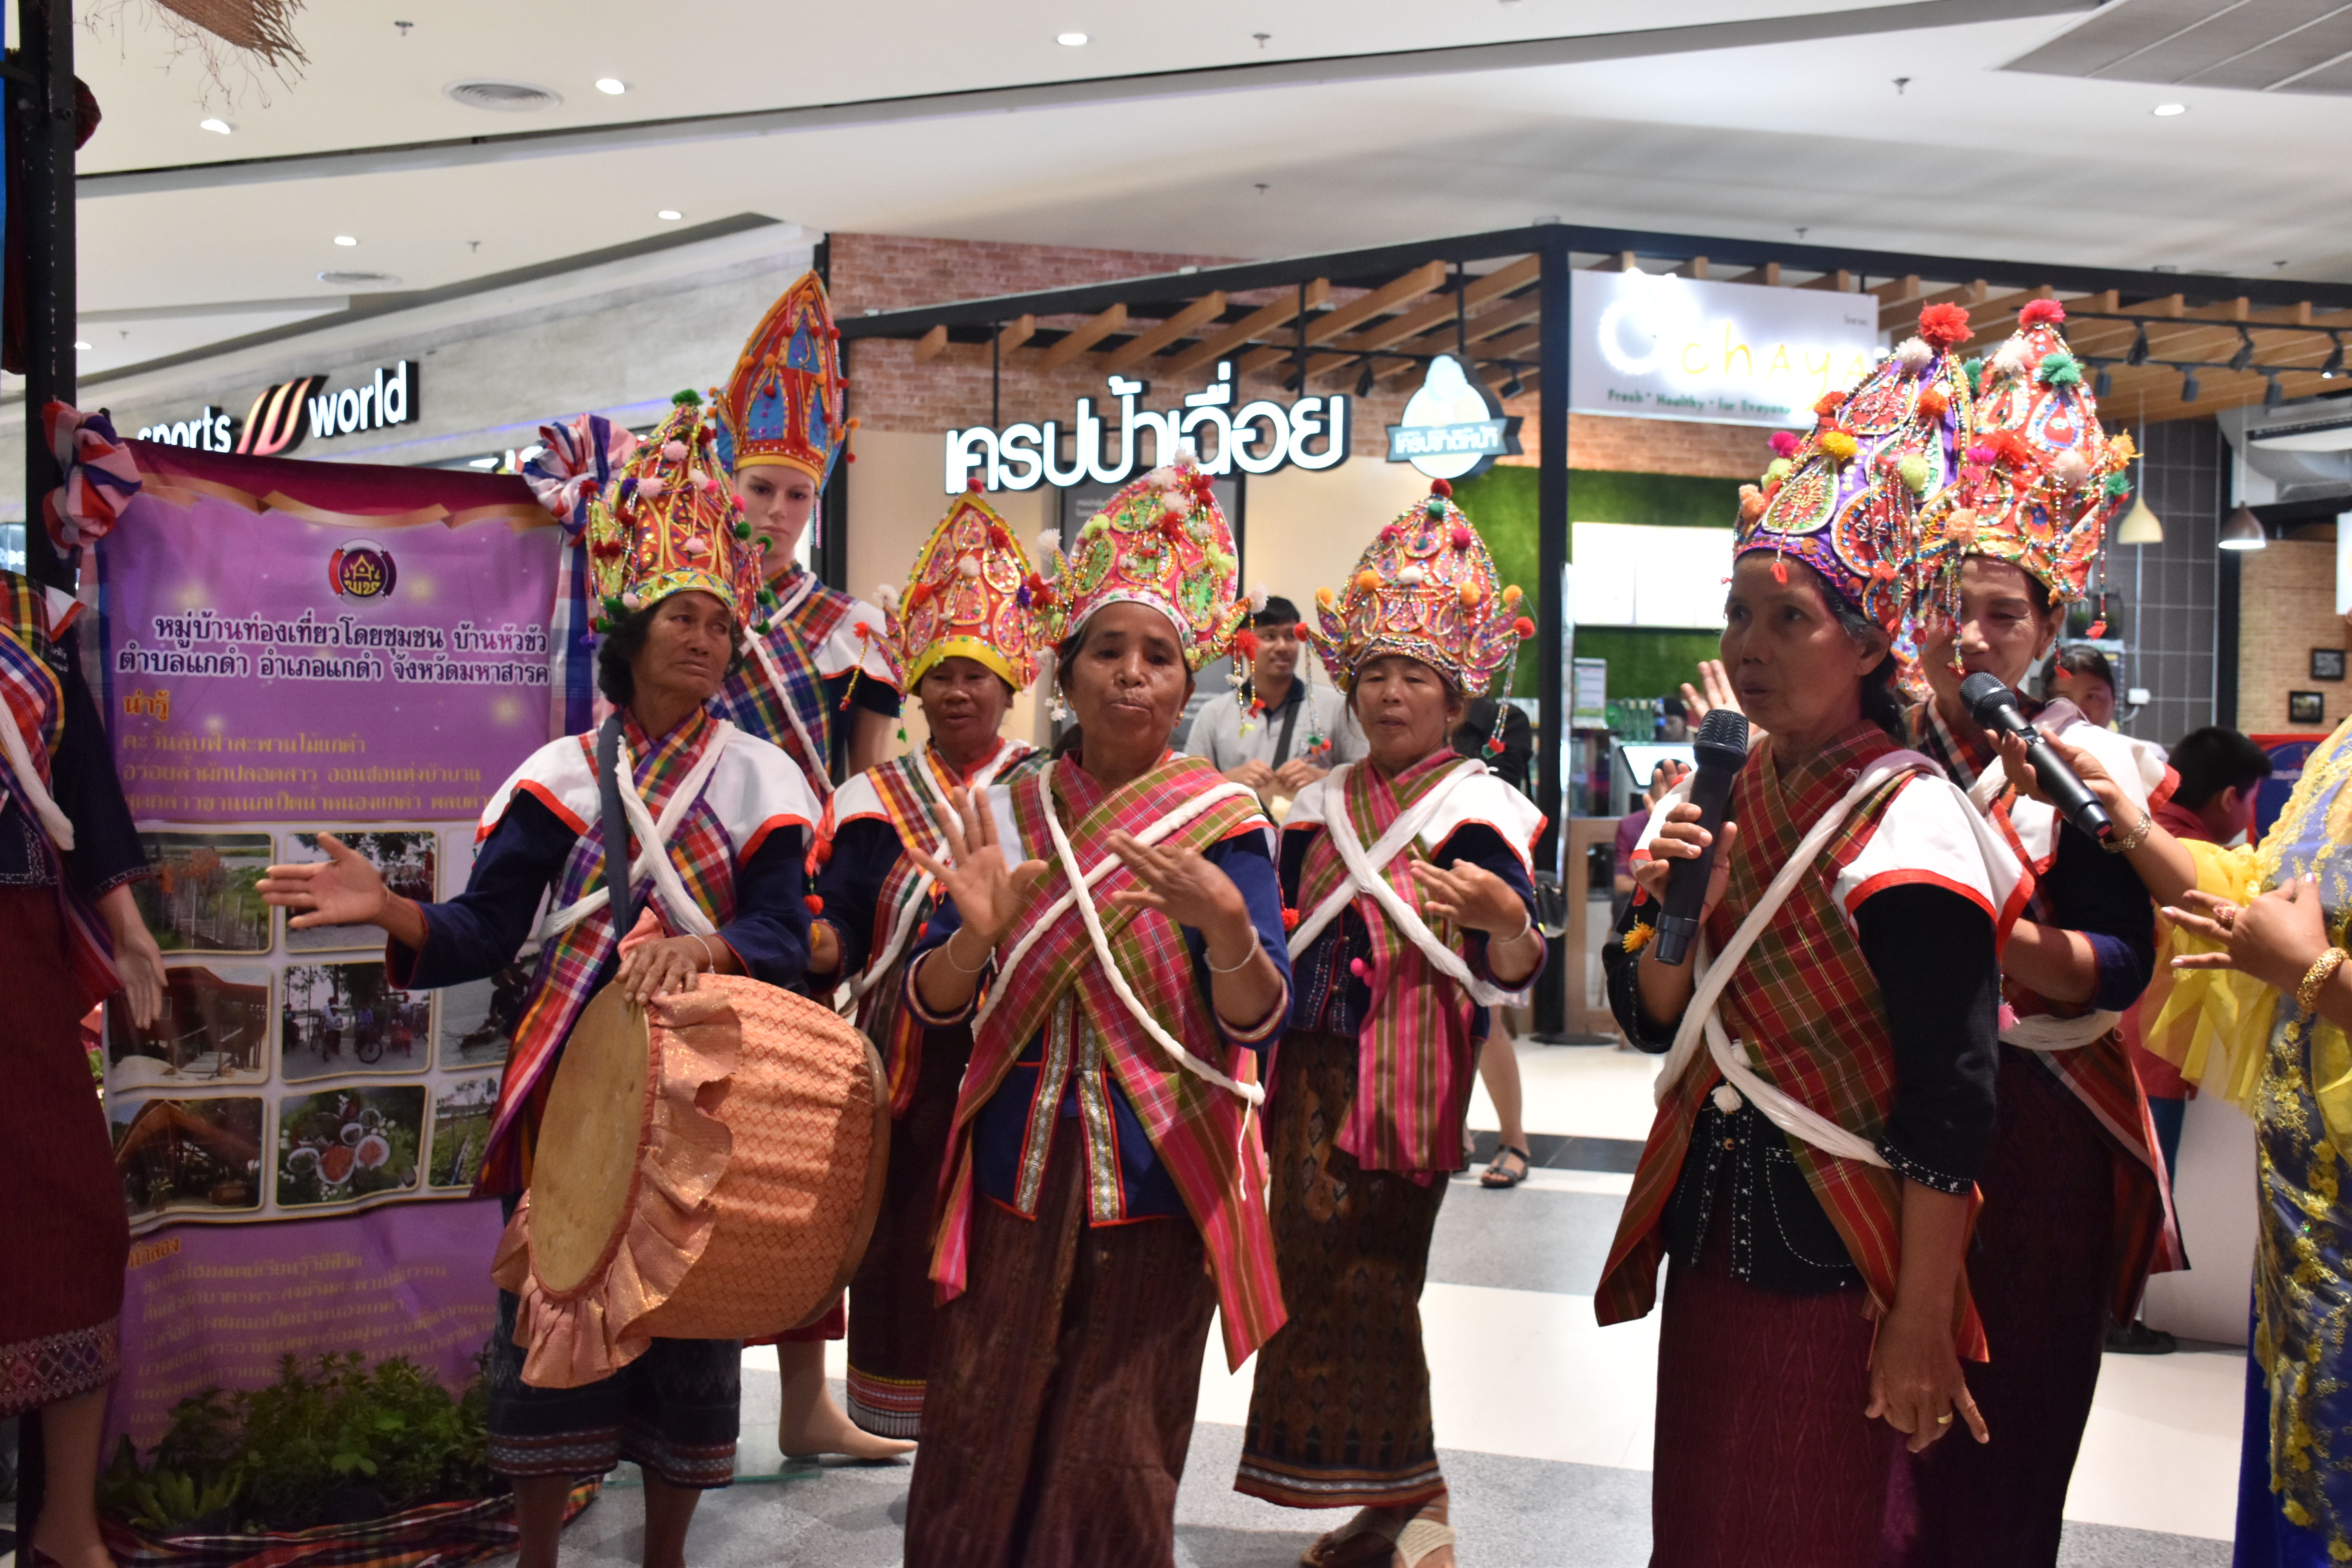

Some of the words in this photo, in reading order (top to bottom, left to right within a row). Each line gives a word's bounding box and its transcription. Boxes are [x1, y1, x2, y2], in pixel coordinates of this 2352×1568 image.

[309, 360, 407, 438] world
[946, 361, 1344, 494] เครปป้าเฉื่อย
[155, 610, 444, 655] หมู่บ้านท่องเที่ยวโดยชุมชน
[454, 623, 547, 652] บ้านหัวขัว
[119, 642, 249, 675] ตำบลแกดำ
[260, 648, 382, 679] อำเภอแกดำ
[123, 688, 170, 721] น่ารู้
